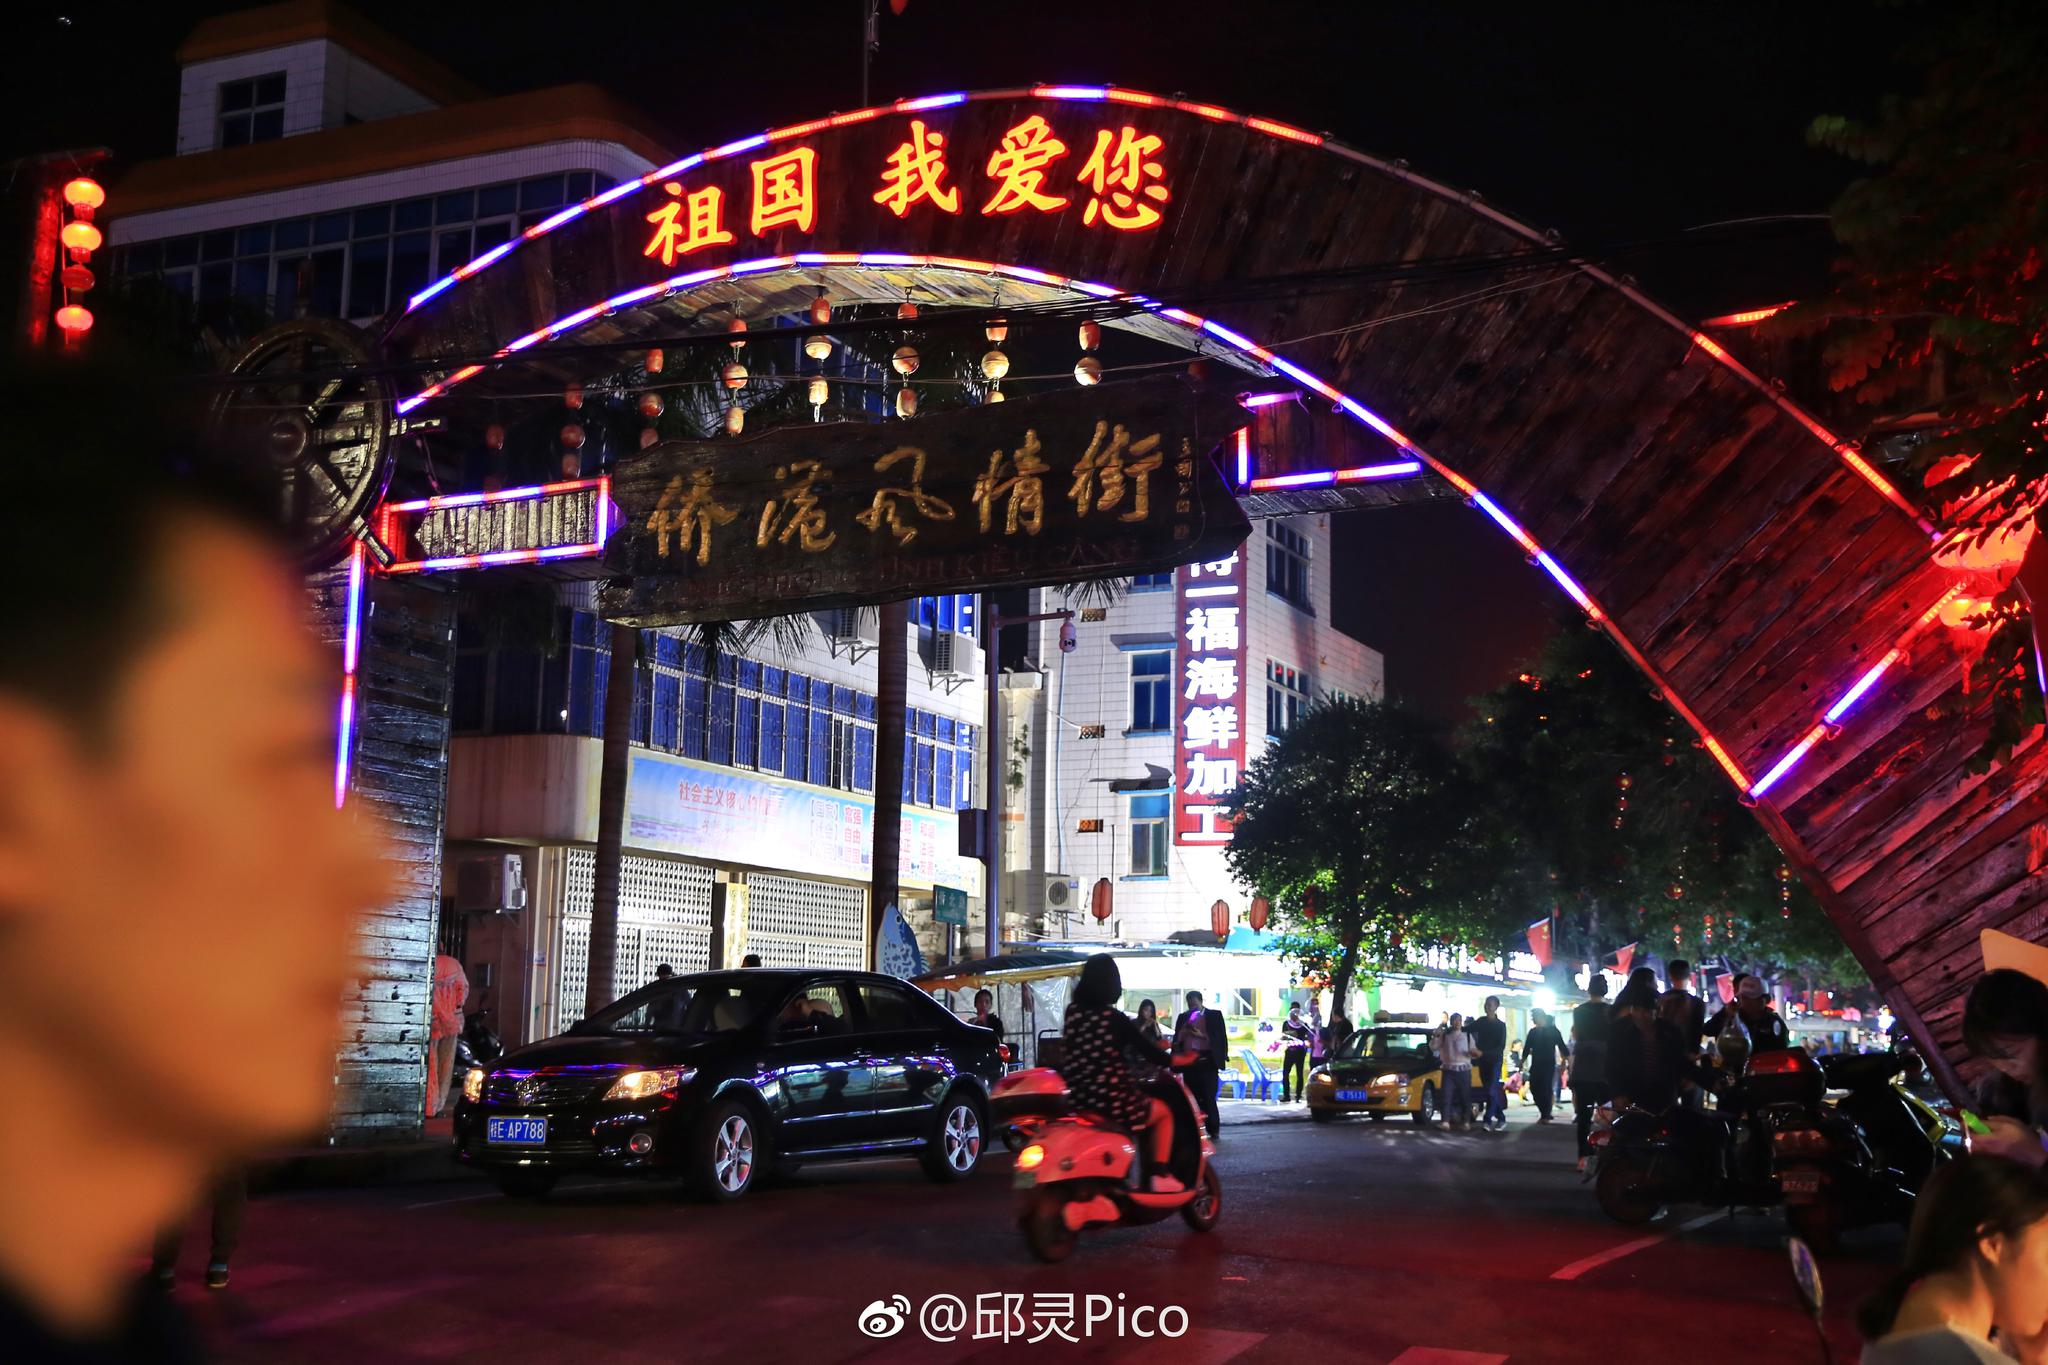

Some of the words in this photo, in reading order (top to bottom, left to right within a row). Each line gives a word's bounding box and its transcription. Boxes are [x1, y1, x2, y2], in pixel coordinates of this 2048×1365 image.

[643, 146, 820, 266] 祖国
[872, 114, 1170, 232] 我爱您
